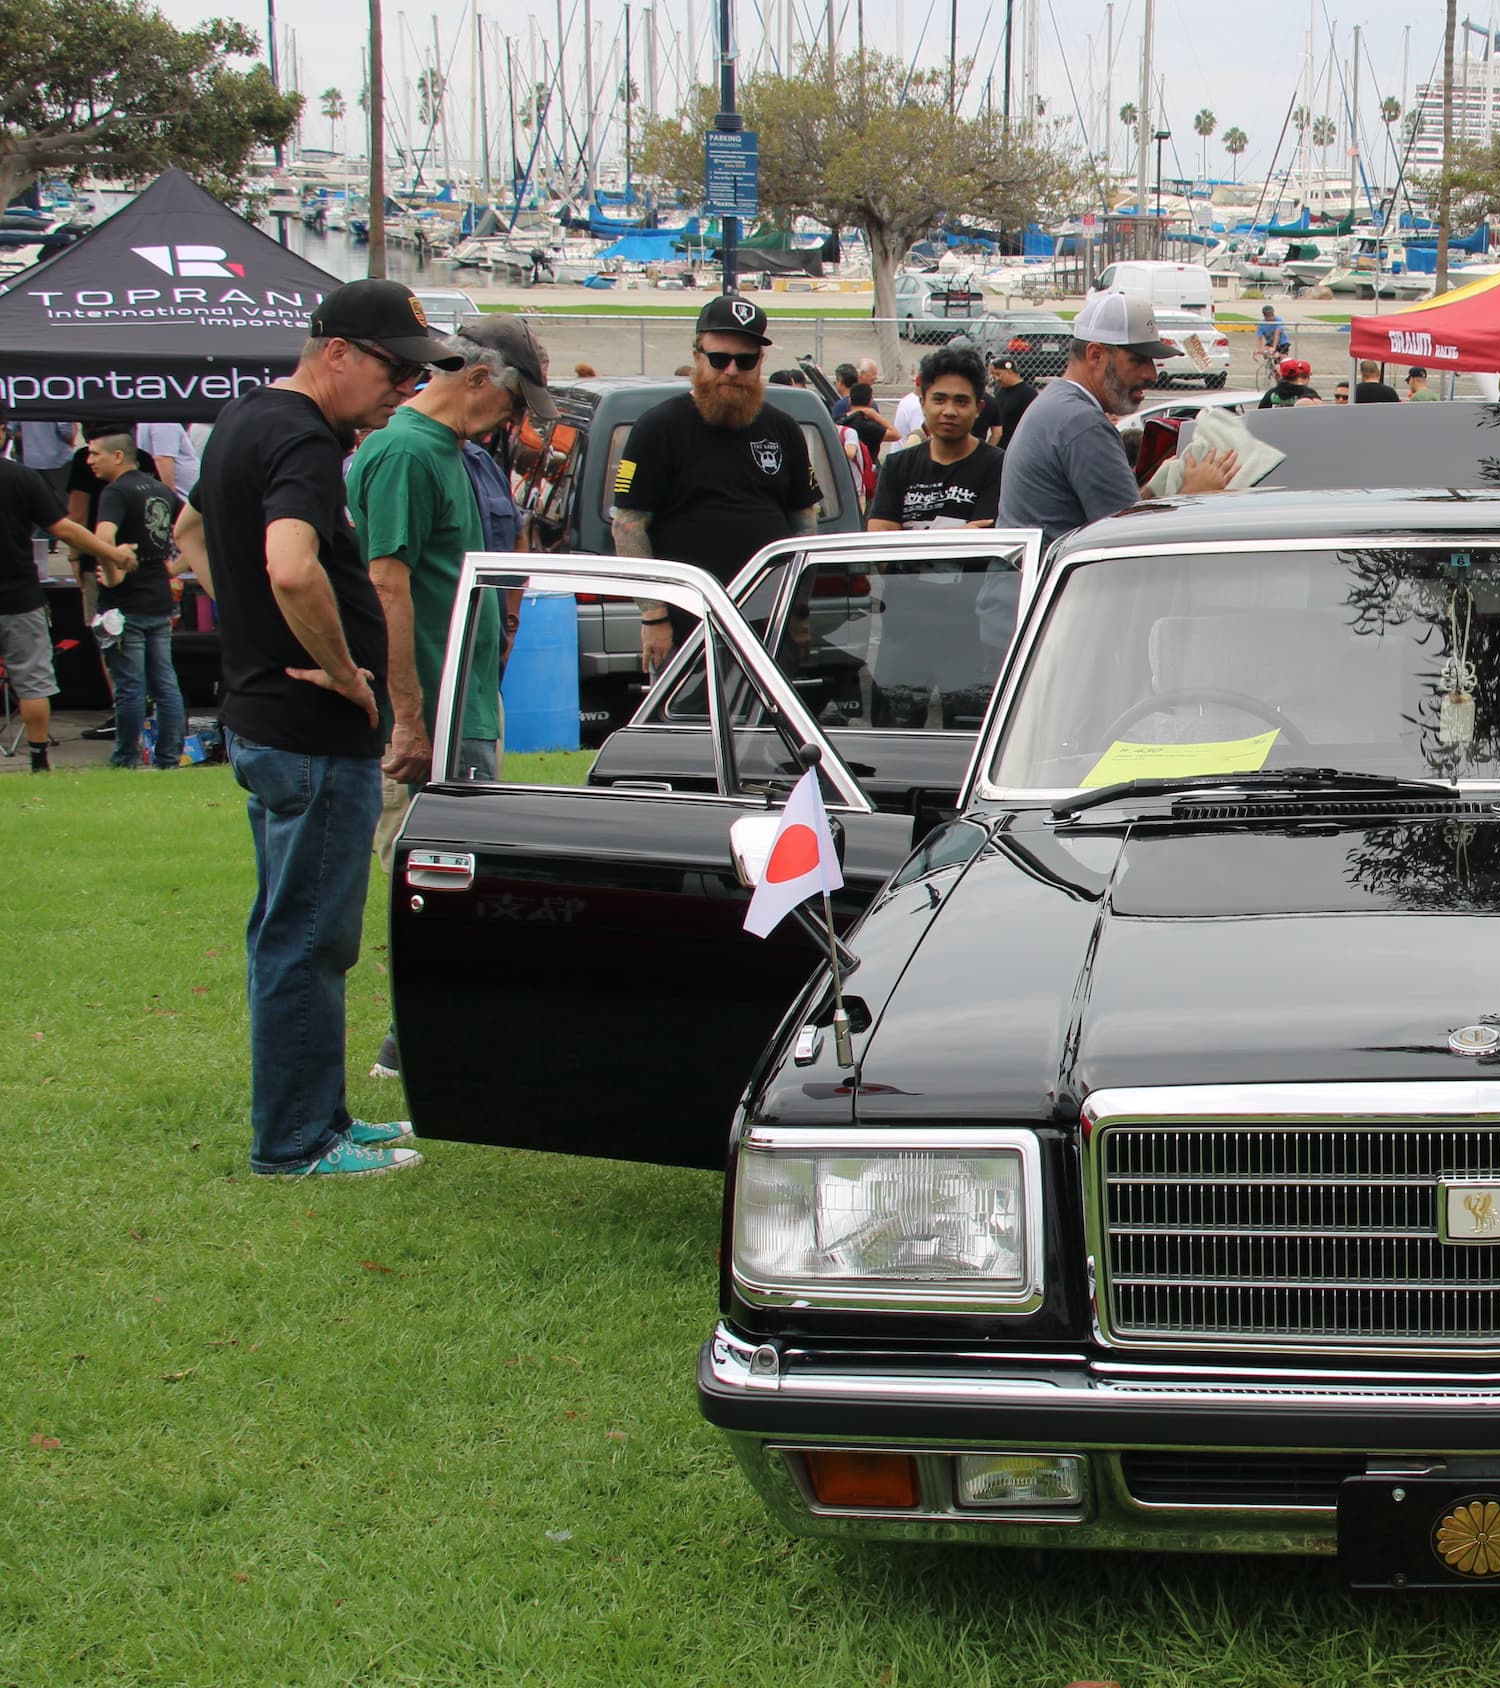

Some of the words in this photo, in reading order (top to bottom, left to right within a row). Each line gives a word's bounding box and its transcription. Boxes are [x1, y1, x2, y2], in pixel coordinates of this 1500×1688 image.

[709, 134, 742, 143] PARKING
[28, 288, 325, 306] TOPRAN
[48, 306, 233, 320] International
[242, 306, 313, 320] Vehic
[201, 316, 312, 329] Importe
[1388, 330, 1432, 357] BRAUM
